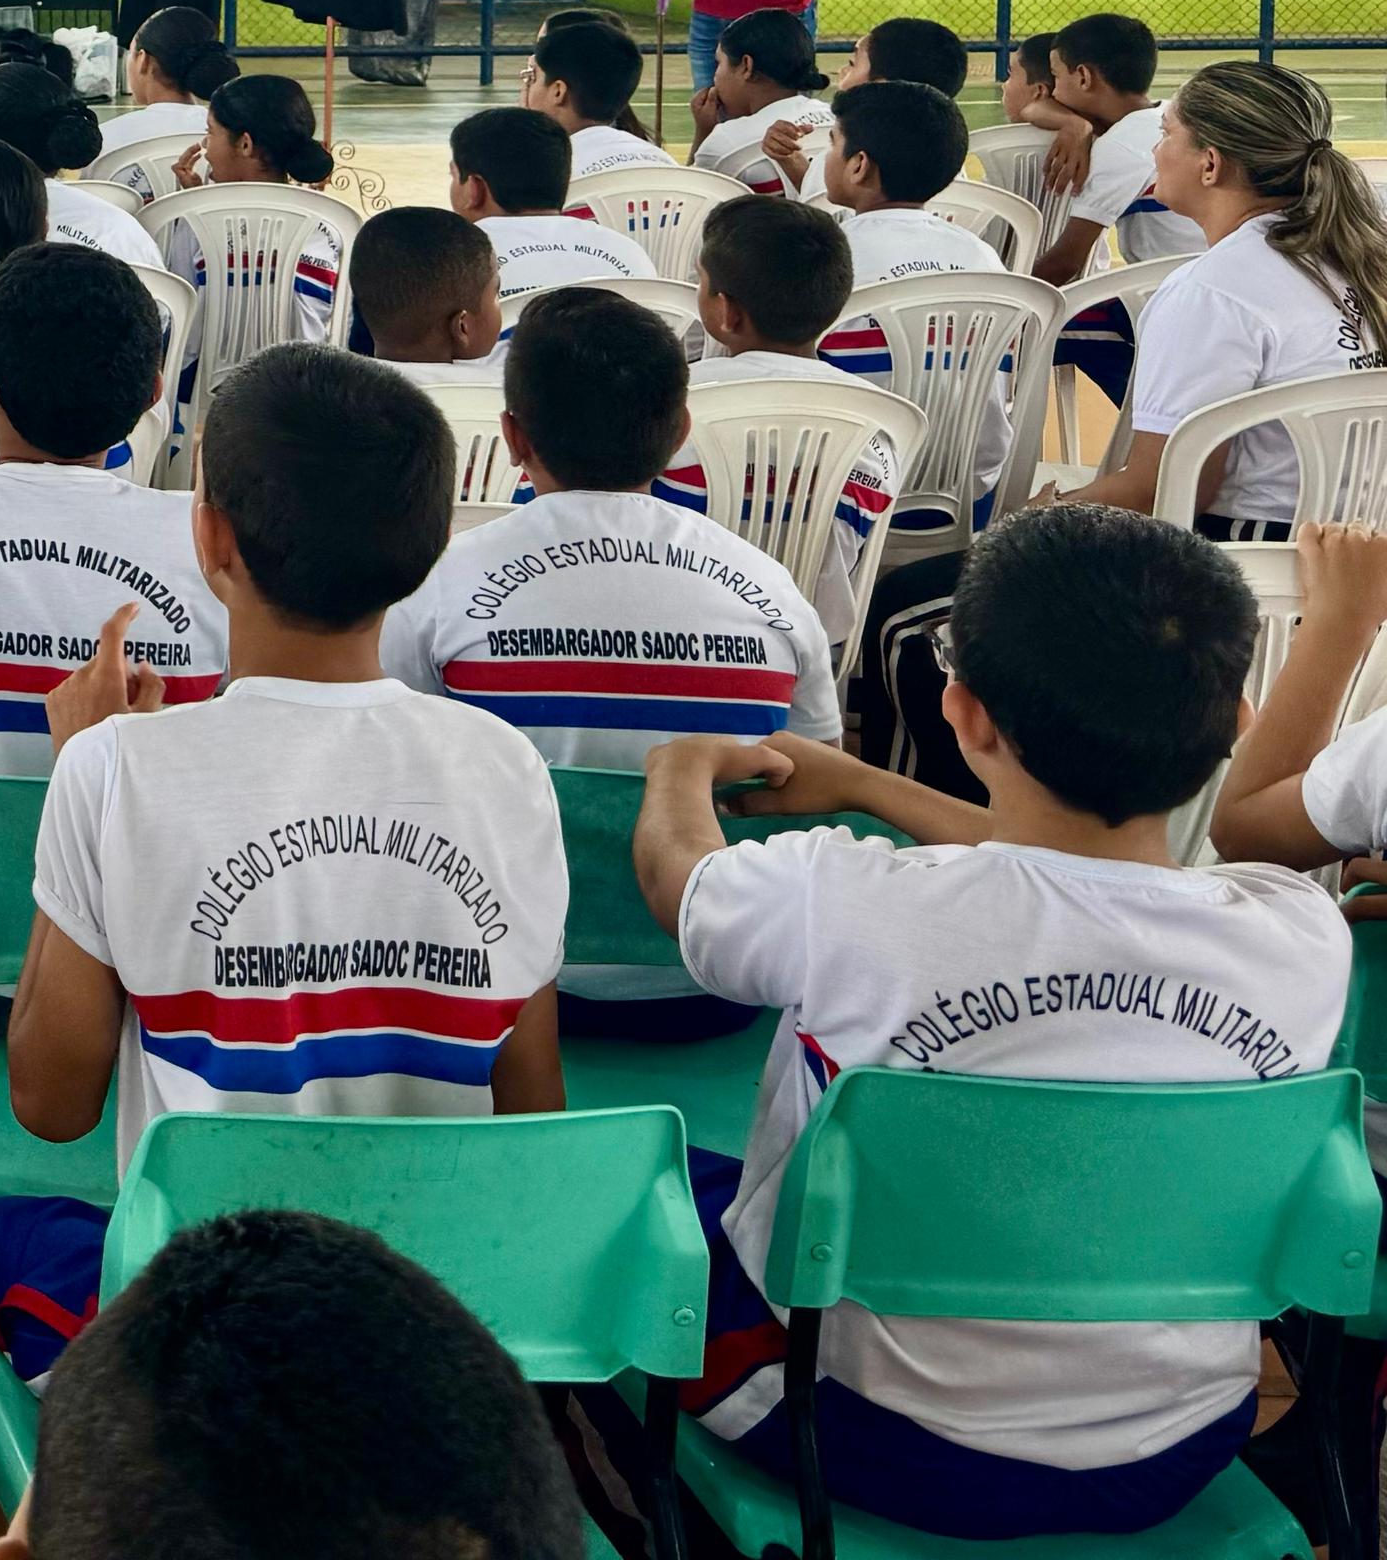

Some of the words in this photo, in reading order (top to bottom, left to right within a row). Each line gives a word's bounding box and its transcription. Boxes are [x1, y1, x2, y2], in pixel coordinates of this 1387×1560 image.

[509, 243, 567, 258] ESTADUAL
[574, 244, 631, 277] MILITARIZA
[890, 261, 944, 278] ESTADUAL
[848, 469, 883, 489] EREIRA
[75, 545, 191, 634] MILITARIZADO
[465, 554, 546, 620] COLÉGIO
[543, 537, 660, 571] ESTADUAL
[665, 543, 794, 632] MILITARIZADO
[58, 637, 100, 661] SAD
[124, 640, 191, 666] PEREIRA
[487, 628, 639, 658] DESEMBARGADOR
[642, 631, 699, 662] SADOC
[704, 633, 768, 665] PEREIRA
[190, 841, 274, 942] COLÉGIO
[269, 814, 380, 868] ESTADUAL
[382, 819, 509, 945] MILITARIZADO
[214, 942, 349, 989] DESEMBRGADOR
[350, 939, 410, 978] SADOC
[412, 940, 492, 989] PEREIRA
[889, 981, 1020, 1065] COLÉGIO
[1024, 973, 1166, 1021] ESTADUAL
[1171, 983, 1301, 1081] MILITARIZA
